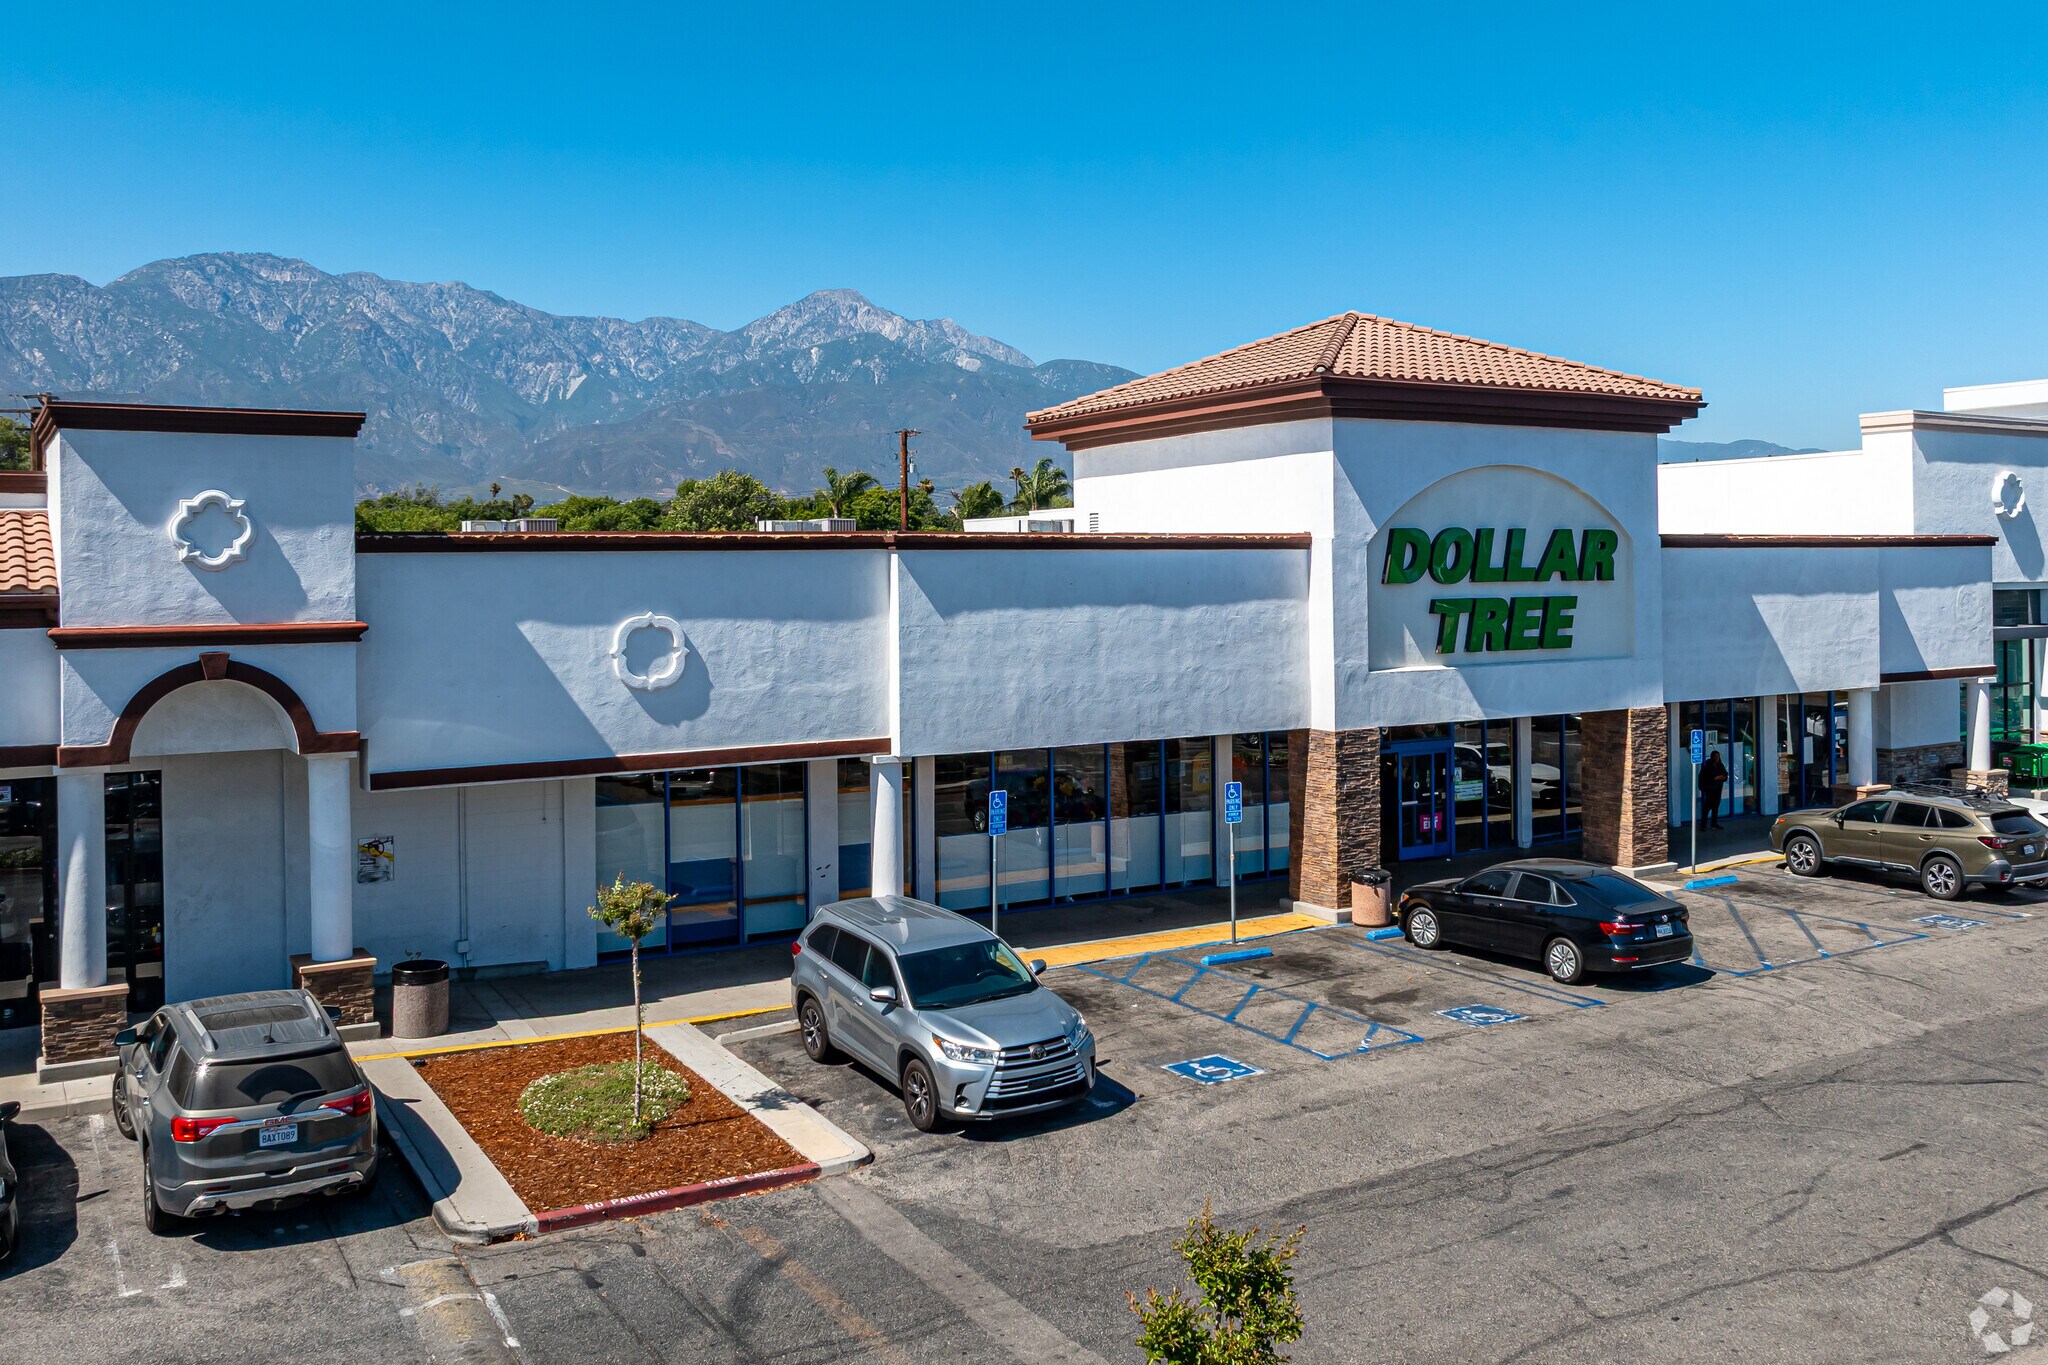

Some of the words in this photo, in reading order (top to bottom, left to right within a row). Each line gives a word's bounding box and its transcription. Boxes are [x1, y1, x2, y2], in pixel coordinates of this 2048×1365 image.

[1382, 527, 1618, 584] DOLLAR
[1429, 595, 1578, 654] TREE
[261, 1130, 296, 1144] 8AXT089
[705, 1176, 738, 1187] FIRE
[584, 1201, 604, 1210] NO
[610, 1189, 668, 1205] PARKING
